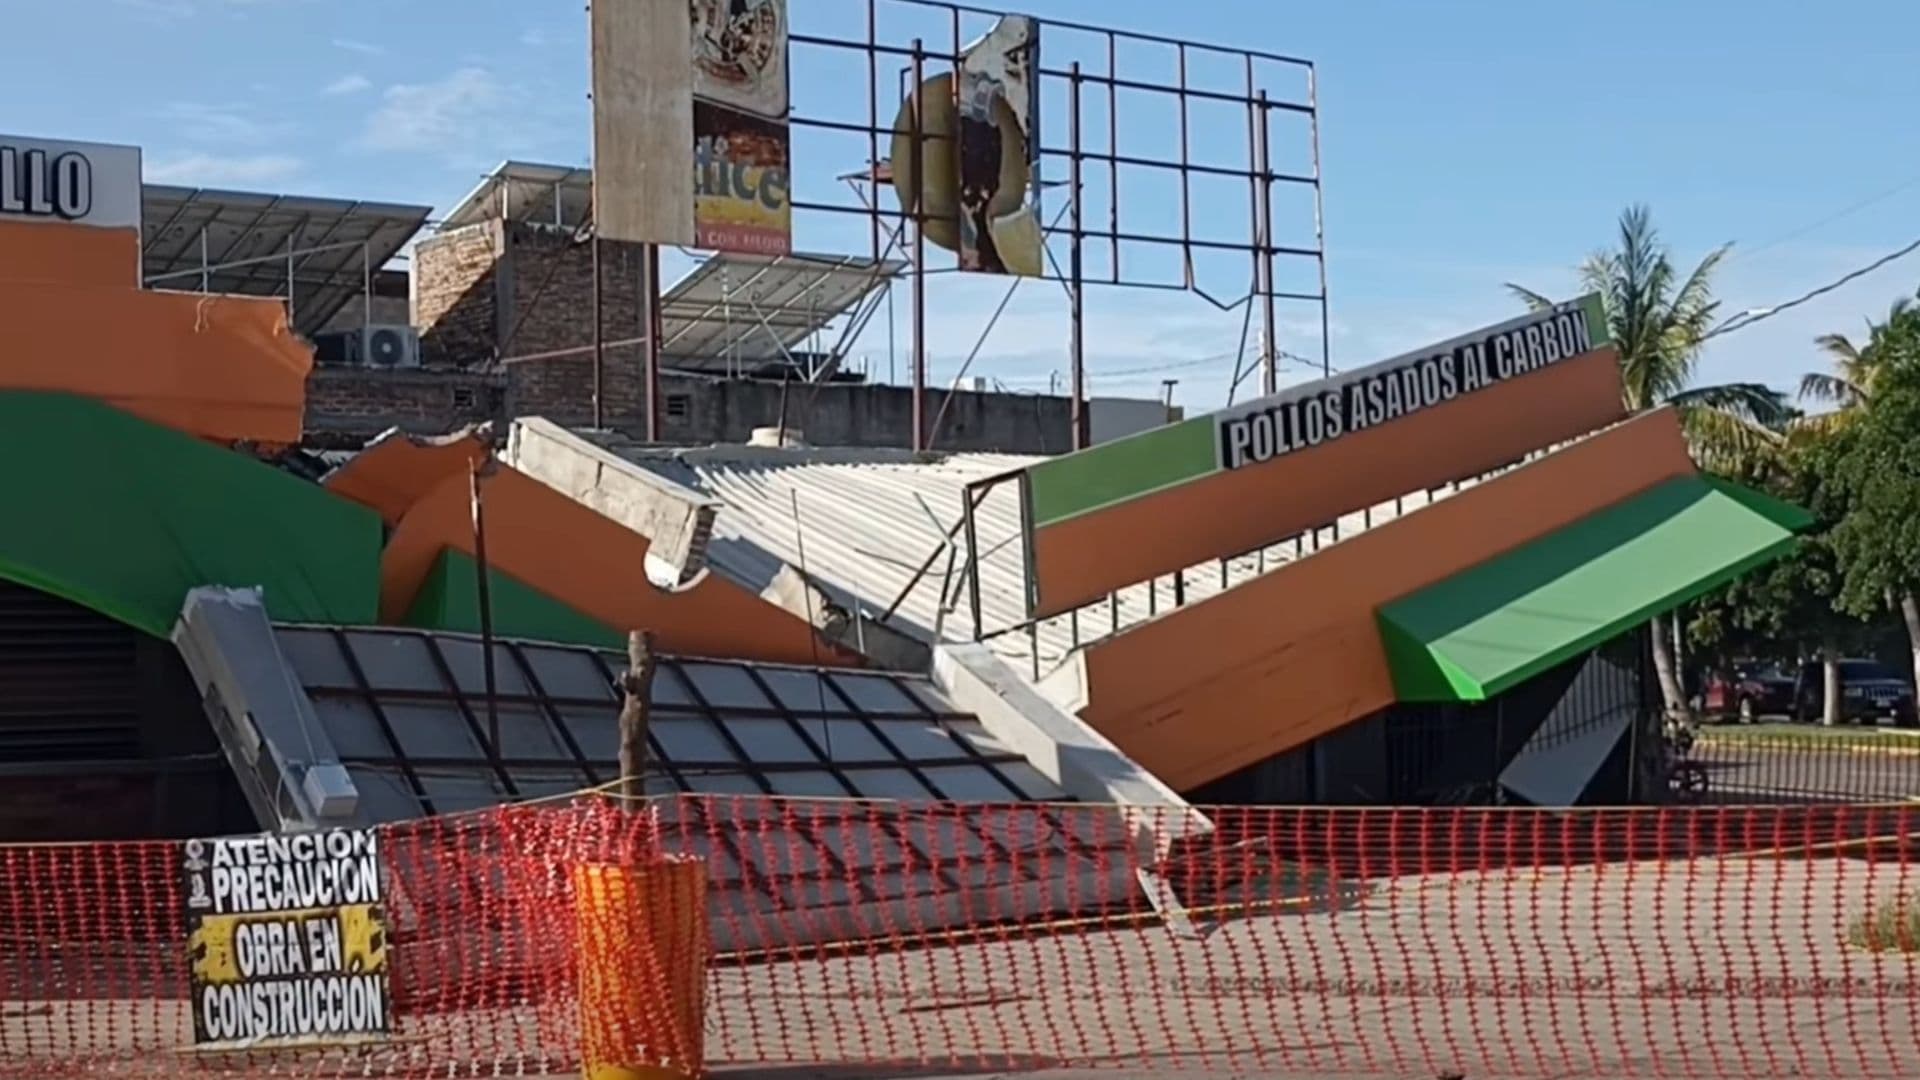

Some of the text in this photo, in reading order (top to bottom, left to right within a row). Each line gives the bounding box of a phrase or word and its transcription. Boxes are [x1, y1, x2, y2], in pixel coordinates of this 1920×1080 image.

[1223, 389, 1344, 470] POLLOS
[1342, 352, 1458, 432] ASADOS
[1453, 342, 1492, 393] AL
[236, 917, 342, 977] OBRA EN
[203, 959, 383, 1039] CONSTRUCCIÓN
